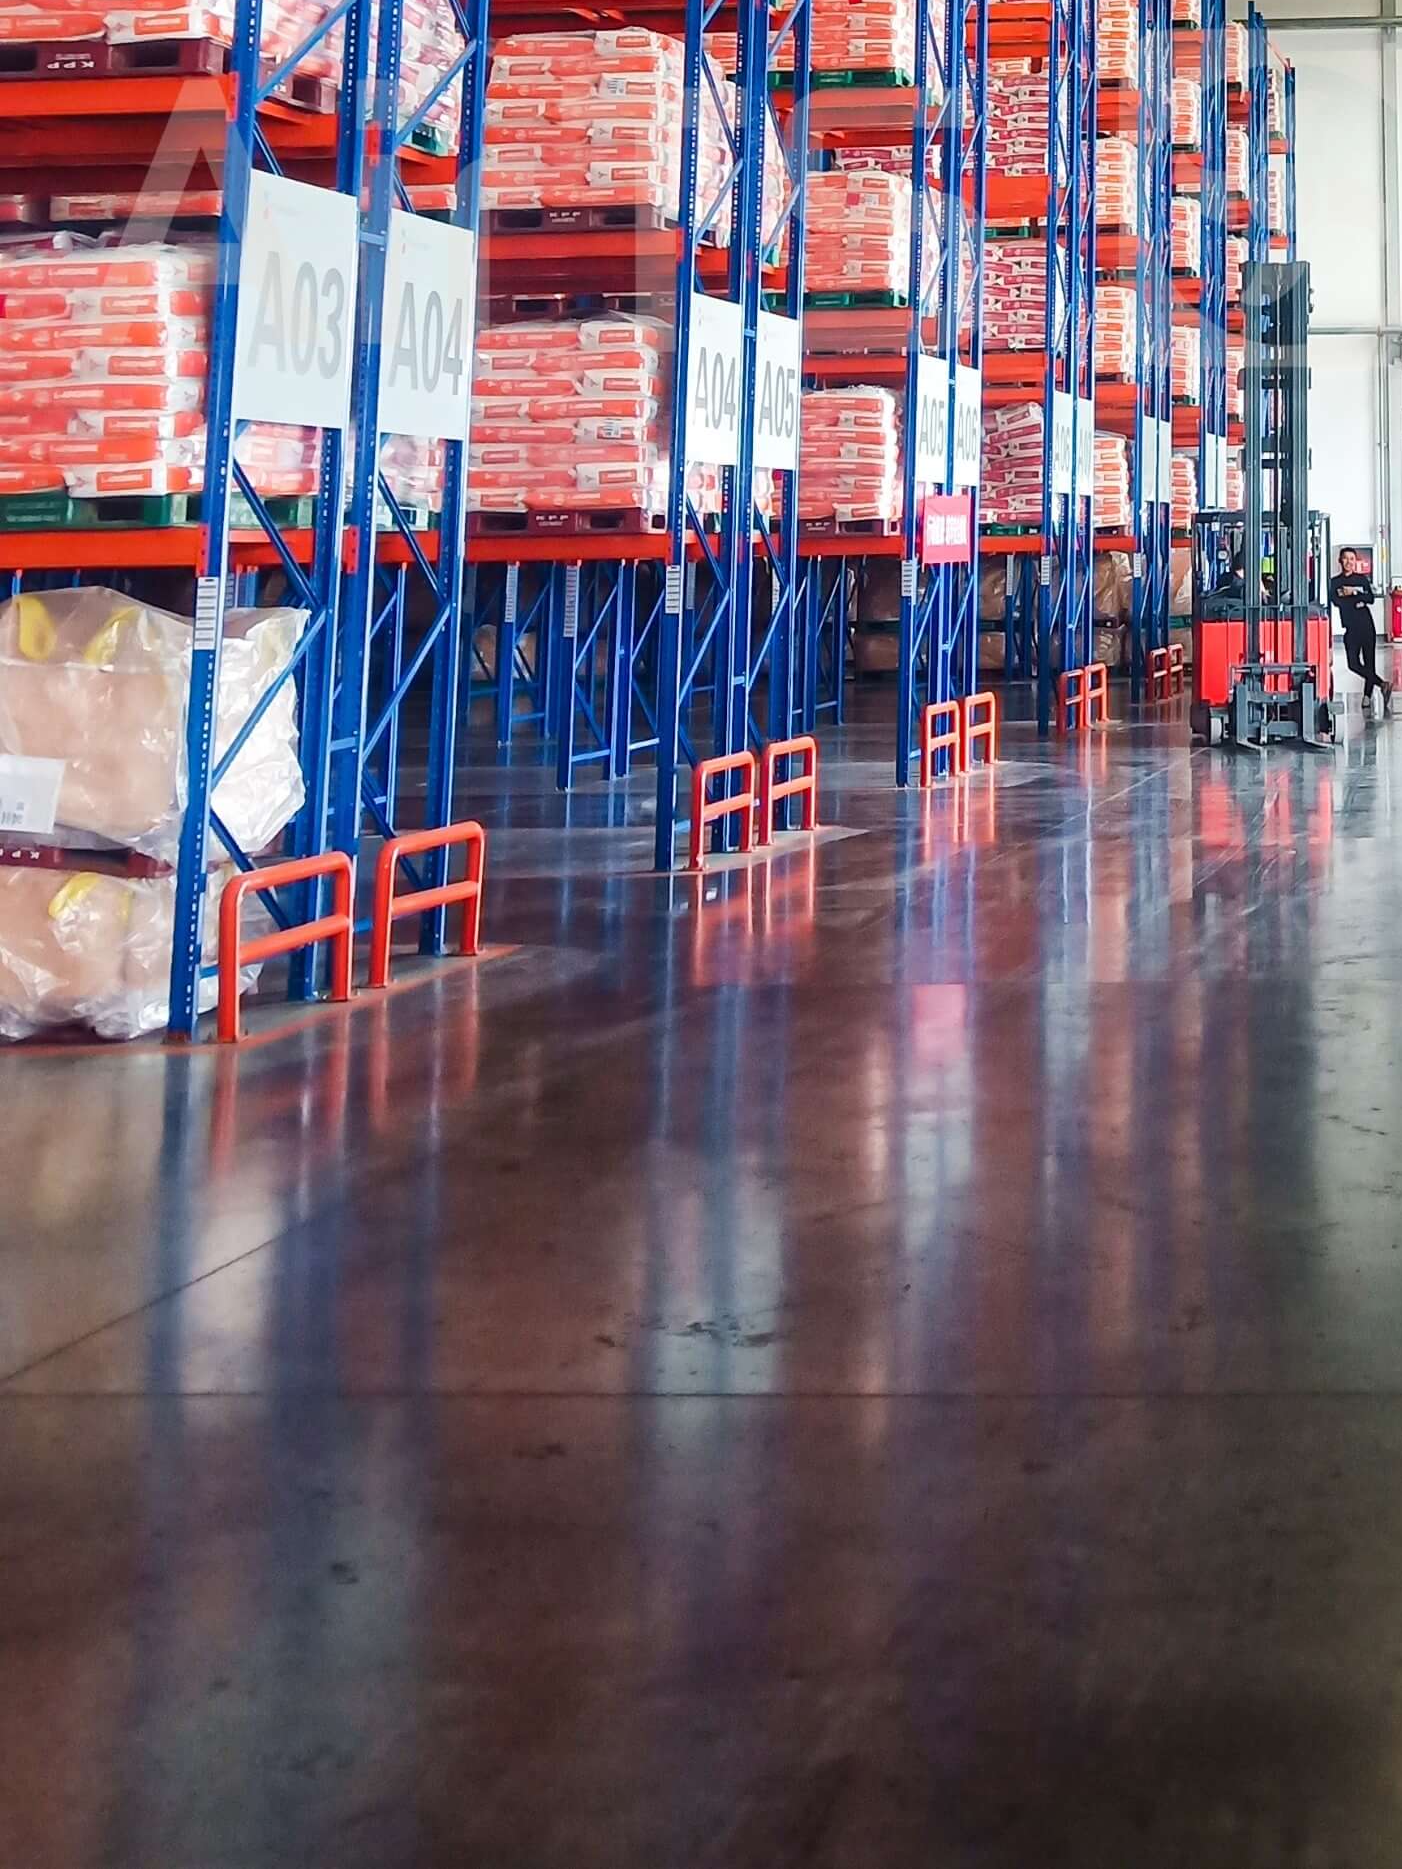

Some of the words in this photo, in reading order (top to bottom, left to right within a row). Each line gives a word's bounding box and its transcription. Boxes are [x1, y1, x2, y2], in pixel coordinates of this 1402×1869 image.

[247, 250, 345, 380] A03
[387, 281, 463, 396] A04
[692, 346, 736, 432] A04
[758, 360, 796, 438] A05
[919, 394, 945, 457] A05
